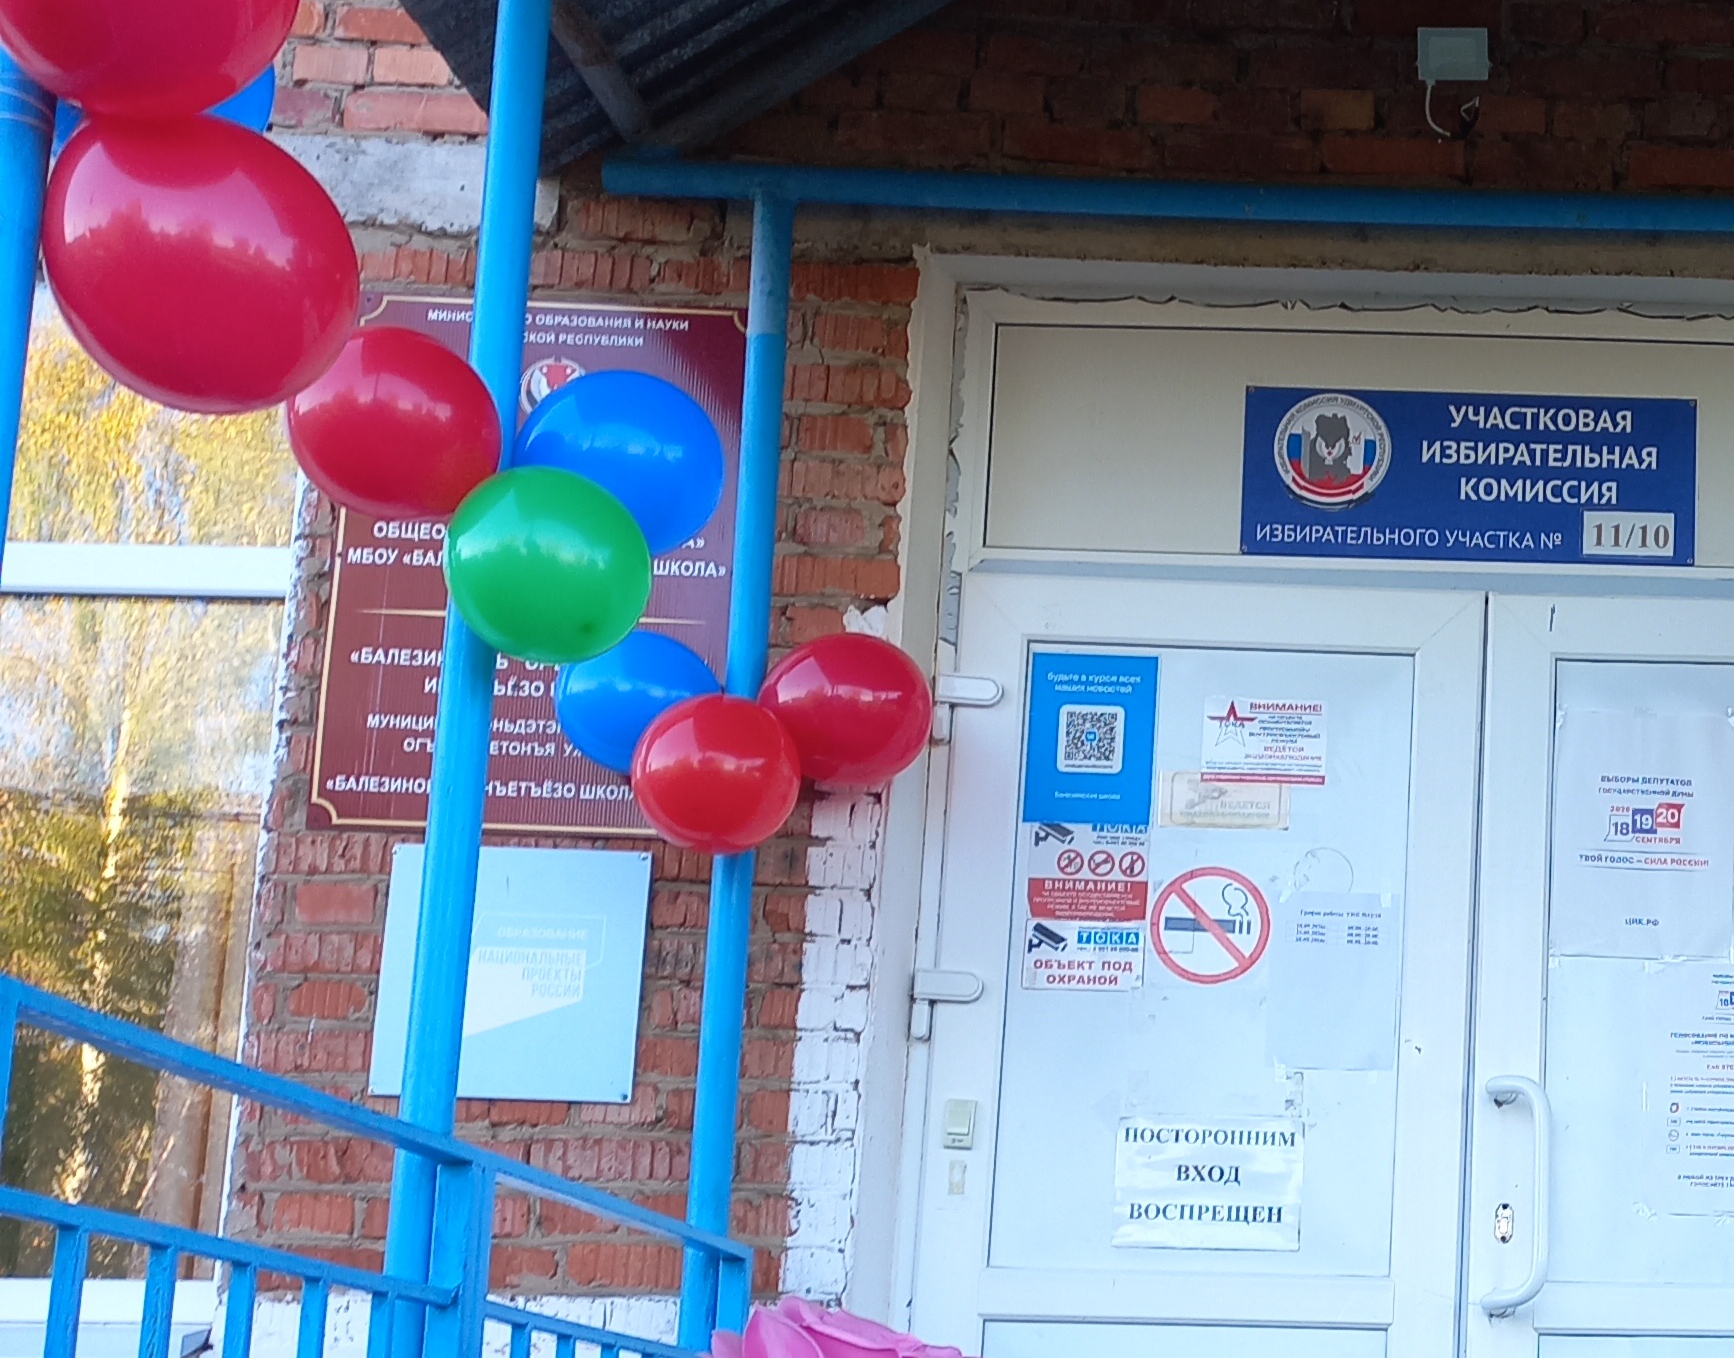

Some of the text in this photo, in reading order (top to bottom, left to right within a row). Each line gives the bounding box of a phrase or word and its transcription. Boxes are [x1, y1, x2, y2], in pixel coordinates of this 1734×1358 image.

[535, 313, 631, 329] ОБРАЗОВАНИЯ
[635, 317, 643, 329] И
[647, 317, 689, 331] НАУКИ
[559, 333, 644, 347] РЕСПУБЛИКИ
[1448, 405, 1633, 434] УЧАСТКОВАЯ
[1421, 440, 1658, 470] ИЗБИРАТЕЛЬНАЯ
[1459, 477, 1618, 505] КОМИССИЯ
[1256, 521, 1670, 551] ИЗБИРАТЕЛЬНОГО УЧАСТКА № 11/10
[347, 548, 398, 565] МБОУ
[653, 557, 727, 578] ШКОЛА»
[1612, 808, 1679, 836] 18 19 20
[1080, 932, 1137, 944] ТОКА
[478, 949, 584, 966] НАЦИОНАЛЬНЫЕ
[1034, 959, 1133, 973] ОБЪЕКТ ПОД
[522, 968, 582, 982] ПРОЕКТЫ
[1047, 974, 1118, 986] ОХРАНОЙ
[531, 983, 581, 997] РОССИИ
[1124, 1126, 1296, 1147] ПОСТОРОННИМ
[1176, 1164, 1241, 1186] ВХОД
[1128, 1203, 1283, 1225] ВОСПРЕЩЕН
